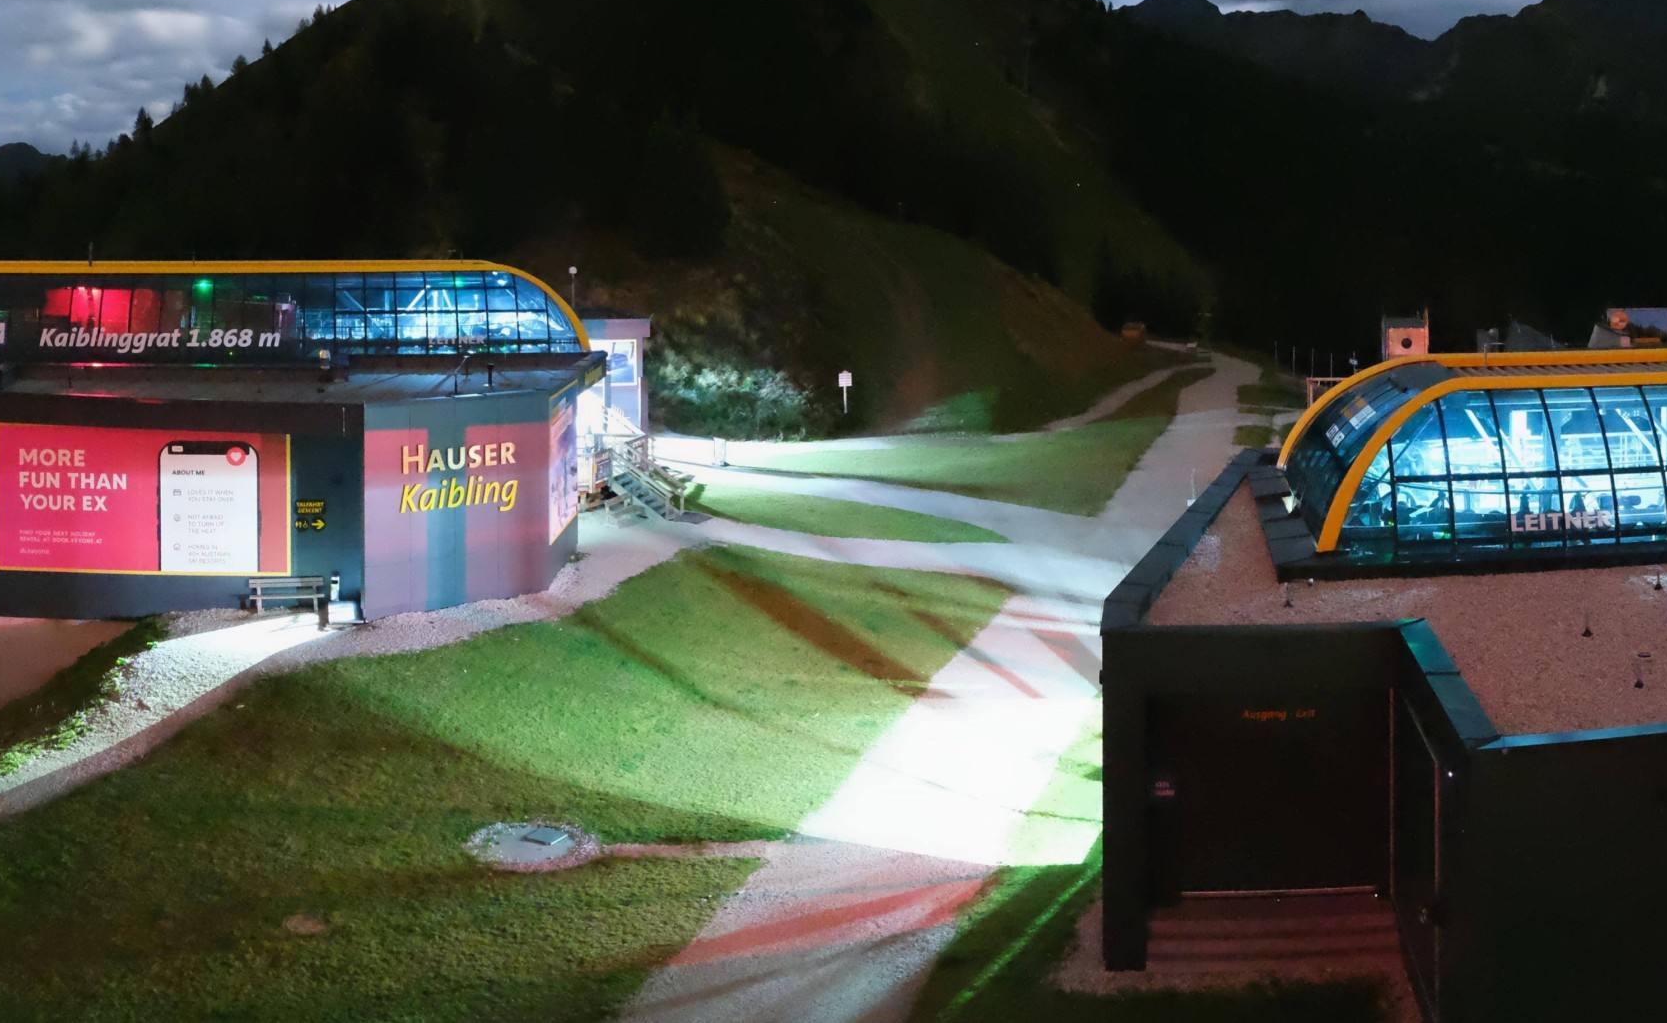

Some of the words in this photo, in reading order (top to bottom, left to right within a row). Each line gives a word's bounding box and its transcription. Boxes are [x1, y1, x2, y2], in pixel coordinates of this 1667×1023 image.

[39, 327, 180, 354] Kaiblinggrat
[185, 328, 252, 348] 1.868
[258, 331, 280, 348] m
[19, 448, 85, 467] MORE
[401, 441, 516, 474] HAUSER
[19, 471, 60, 488] FUN
[67, 472, 127, 490] THAN
[20, 493, 76, 510] YOUR
[82, 495, 108, 511] EX
[400, 476, 518, 513] Kaibling
[1511, 510, 1613, 532] LEITNER
[1242, 709, 1288, 721] Ausgang
[1296, 708, 1316, 718] Exit
